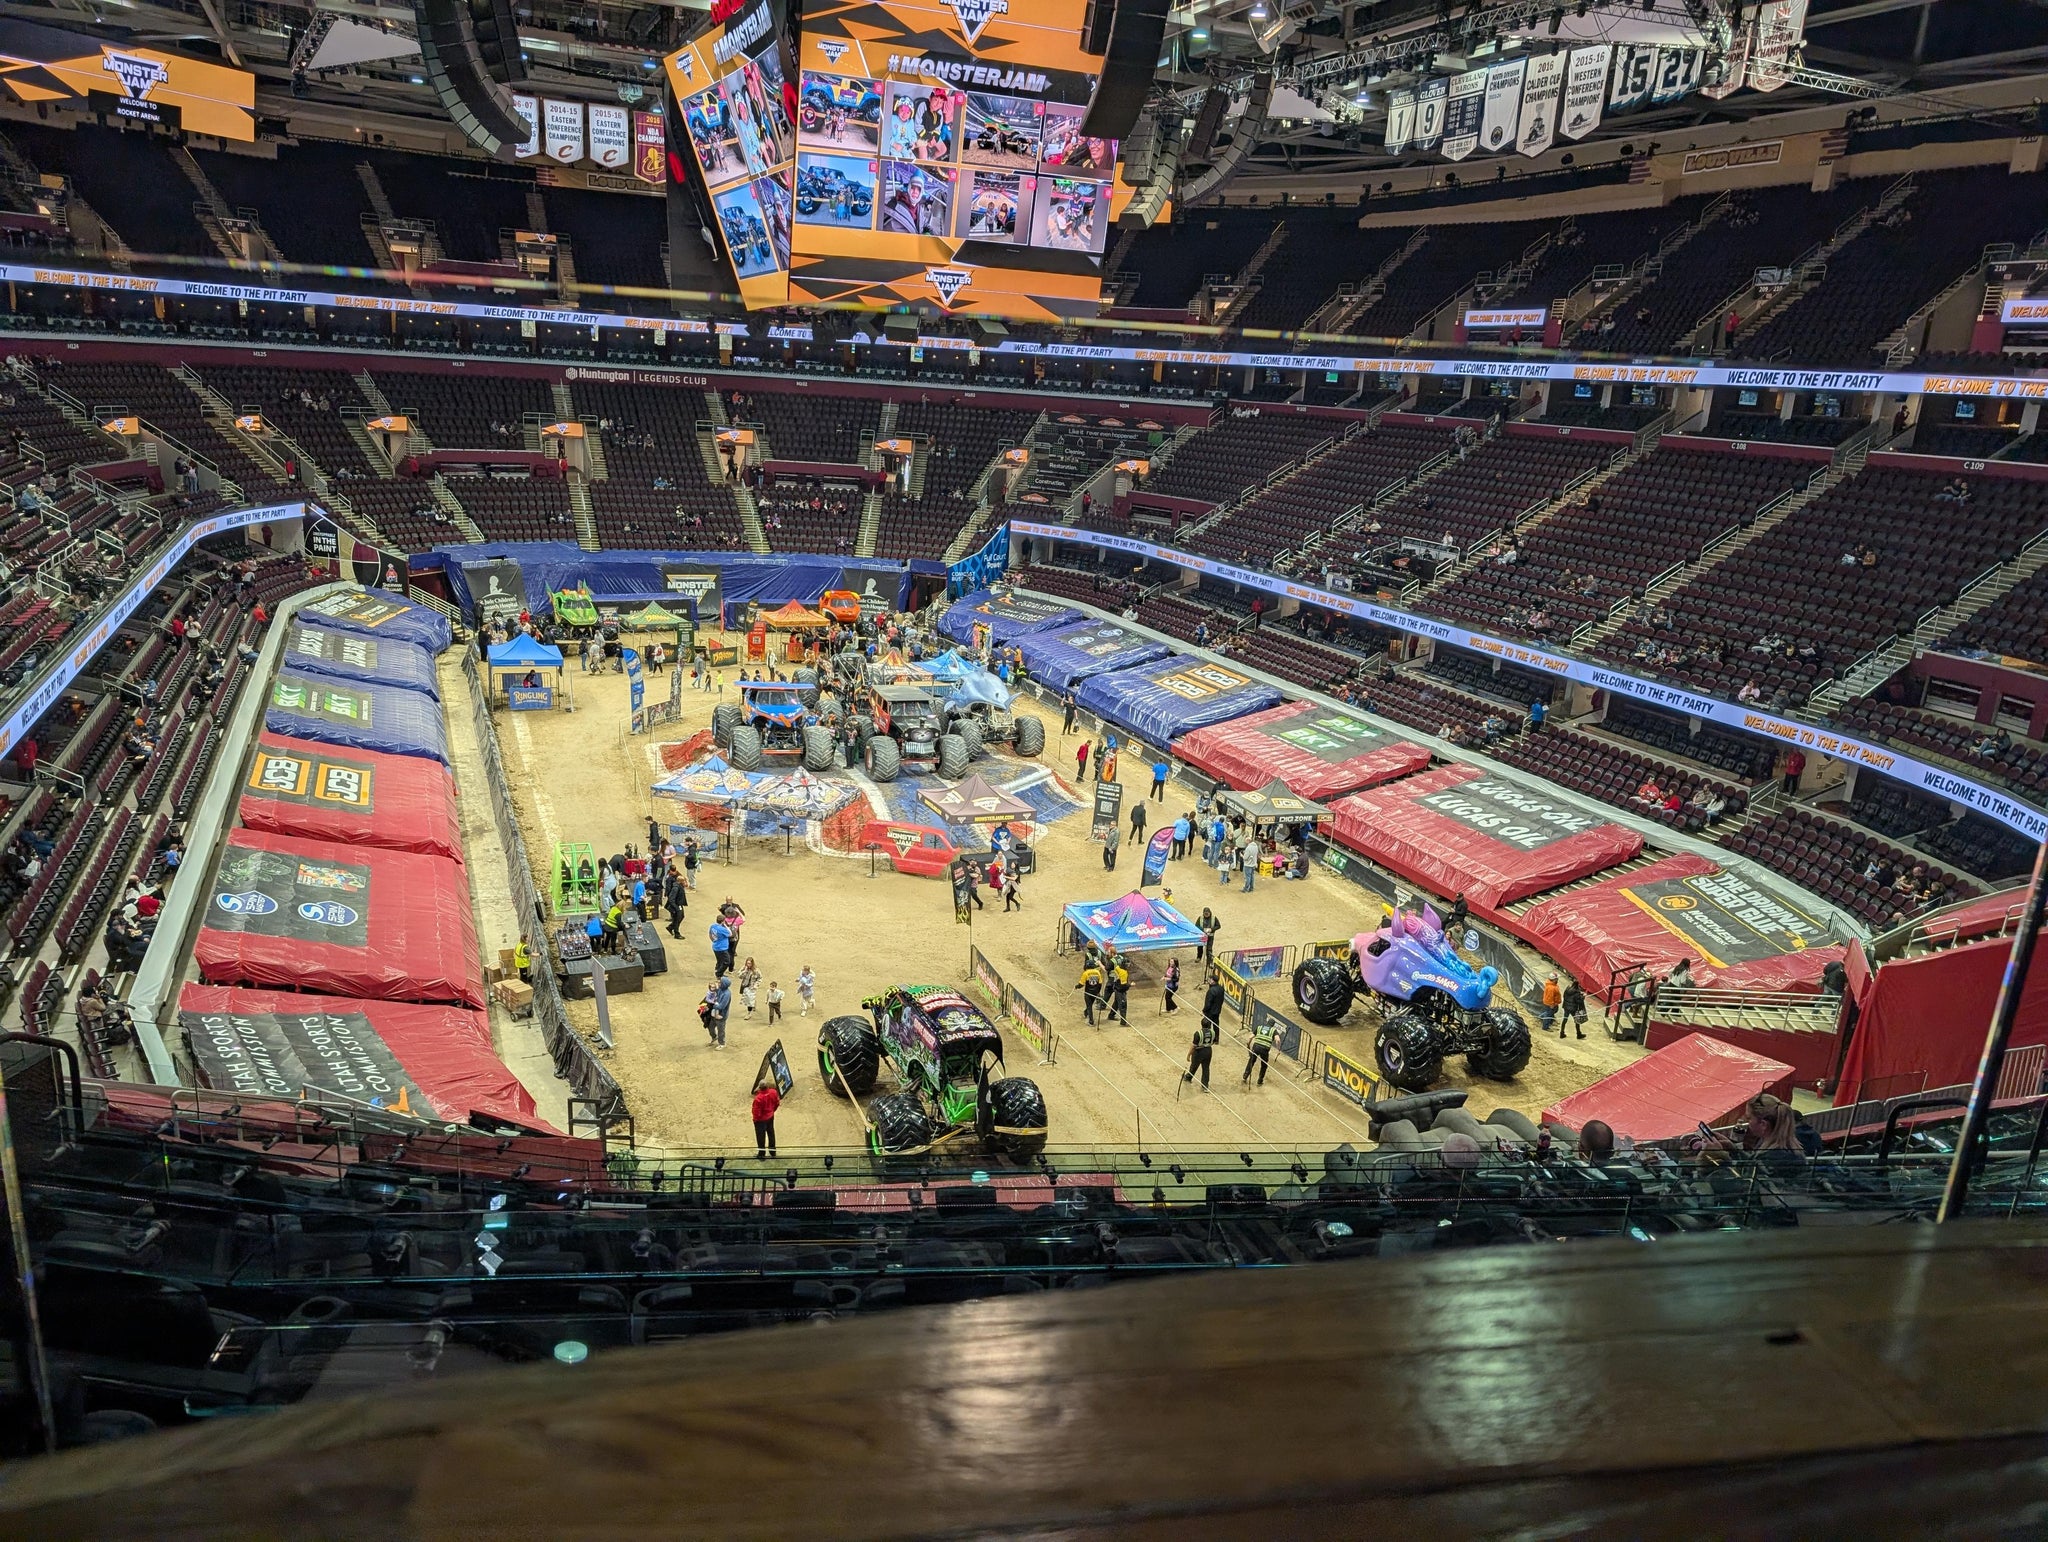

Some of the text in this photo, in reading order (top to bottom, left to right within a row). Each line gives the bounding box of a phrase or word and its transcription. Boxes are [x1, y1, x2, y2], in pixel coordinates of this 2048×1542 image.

[958, 9, 989, 23] JAM
[817, 42, 849, 54] MONSTER
[825, 50, 843, 59] JAM
[1537, 61, 1554, 73] 2016
[1575, 51, 1605, 68] 2015-16
[103, 57, 169, 84] MONSTER
[888, 54, 1047, 93] #MONSTERJAM
[1574, 68, 1603, 82] WESTERN
[1618, 55, 1651, 97] 15
[1662, 50, 1698, 88] 27
[121, 72, 154, 91] JAM
[1451, 71, 1486, 87] CLEVELAND
[1489, 76, 1520, 92] CHAMPIONS
[1526, 73, 1561, 91] CALDER CUP
[1420, 86, 1446, 100] GLOVER
[1455, 82, 1479, 93] BARONS
[1525, 86, 1559, 104] CHAMPIONS
[1567, 80, 1604, 95] CONFERENCE
[119, 97, 158, 111] WELCOME TO
[1392, 94, 1415, 106] BOWER
[1567, 93, 1601, 108] CHAMPIONS
[117, 108, 139, 119] ROCKET
[549, 105, 578, 116] 2014-15
[594, 109, 623, 120] 2015-16
[551, 115, 577, 125] EASTERN
[596, 119, 621, 129] EASTERN
[1397, 109, 1404, 141] 1
[1424, 103, 1435, 135] 9
[547, 122, 582, 134] CONFERENCE
[591, 127, 627, 139] CONFERENCE
[647, 127, 659, 137] NBA
[548, 132, 581, 143] CHAMPIONS
[593, 136, 625, 147] CHAMPIONS
[637, 133, 665, 145] CHAMPION
[925, 273, 972, 286] MONSTER
[939, 283, 959, 292] JAM
[185, 282, 308, 303] WELCOME TO THE PIT PARTY
[484, 307, 599, 324] WELCOME TO THE PIT PARTY
[579, 368, 707, 385] Huntington LEGENDS CLUB
[1453, 362, 1550, 377] WELCOME TO THE PIT PARTY
[1573, 366, 1698, 382] WELCOME TO THE PIT PARTY
[1727, 370, 1885, 389] WELCOME TO THE PIT PARTY
[1923, 377, 2048, 397] WELCOME TO THE
[1034, 478, 1065, 487] Construction.
[226, 508, 287, 526] WELCOME TO THE PIT PARTY
[313, 536, 337, 546] IN THE
[313, 544, 337, 553] PAINT
[667, 581, 716, 590] MONSTER
[682, 589, 704, 597] JAM
[1369, 608, 1450, 639] WELCOME TO THE PIT PARTY
[1195, 667, 1241, 686] JCB
[1162, 677, 1207, 697] JCB
[1592, 670, 1714, 715] WELCOME TO THE PIT PARTY
[278, 685, 301, 707] BKT
[513, 690, 548, 702] RINGLING
[331, 693, 352, 716] BKT
[1289, 728, 1341, 749] BKT
[1743, 714, 1895, 771] WELCOME TO THE PIT PARTY
[1128, 742, 1142, 756] JCB
[263, 758, 300, 790] JCB
[328, 768, 359, 802] JCB
[1274, 799, 1300, 808] JCB
[1467, 782, 1550, 812] LUCAS
[1923, 770, 2046, 838] WELCOME TO THE PIT PAR
[1425, 795, 1549, 848] LUCAS OIL
[886, 831, 921, 844] MONSTER
[896, 838, 912, 847] JAM
[1715, 872, 1746, 894] THE
[245, 894, 258, 911] SPIN
[1690, 876, 1779, 935] SUPER GLUE
[327, 904, 338, 923] SPIN
[1680, 911, 1694, 924] TOOL
[1688, 909, 1746, 945] NORTHERN
[1434, 976, 1459, 992] SMASH
[201, 1016, 261, 1095] UTAH SPORTS
[233, 1017, 291, 1094] COMMISSION
[299, 1016, 364, 1093] UTAH SPORTS
[326, 1014, 392, 1093] COMMISSION
[1328, 1057, 1371, 1099] UNOH
